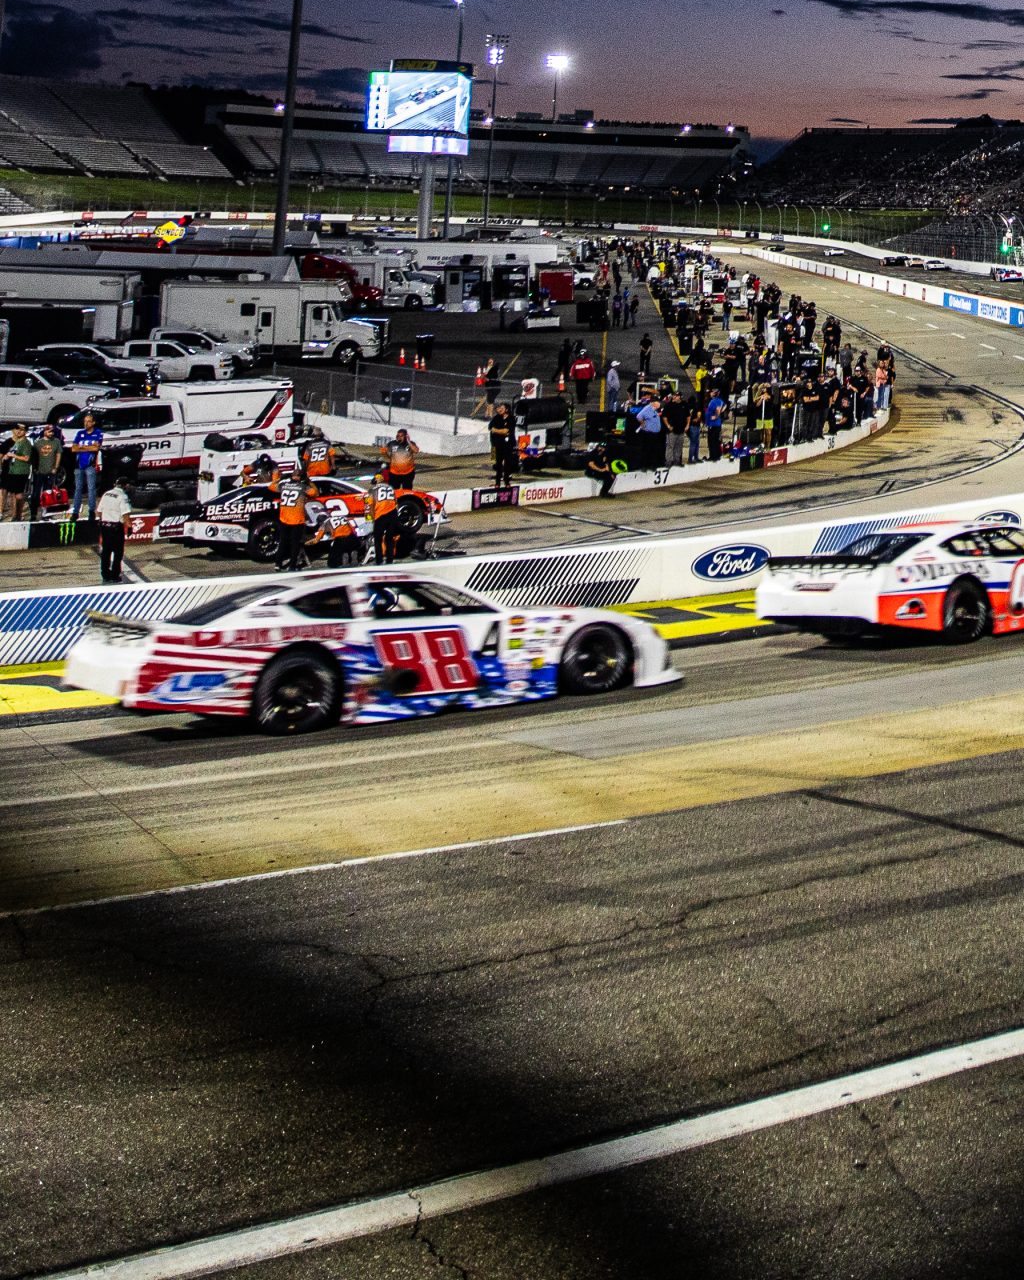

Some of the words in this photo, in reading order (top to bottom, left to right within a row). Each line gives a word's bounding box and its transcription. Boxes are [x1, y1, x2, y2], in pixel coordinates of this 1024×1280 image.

[156, 227, 184, 236] SUNOCO
[310, 447, 327, 462] 62
[653, 470, 669, 485] 37
[377, 486, 394, 501] 62
[480, 493, 498, 504] NEW!
[525, 489, 548, 501] COOK
[548, 487, 564, 499] OUT
[206, 501, 271, 516] BESSEMER
[707, 549, 756, 577] Ford
